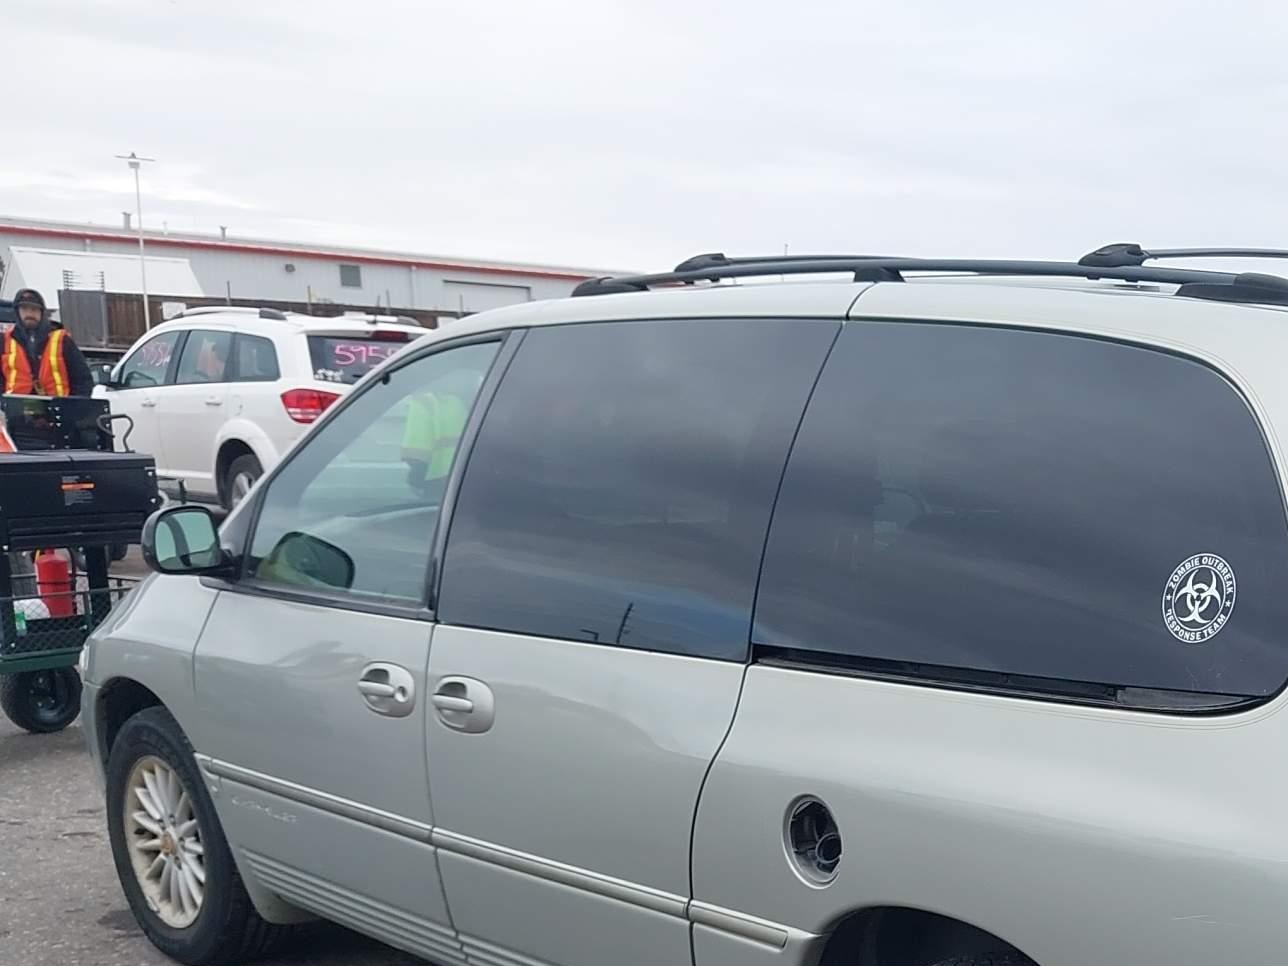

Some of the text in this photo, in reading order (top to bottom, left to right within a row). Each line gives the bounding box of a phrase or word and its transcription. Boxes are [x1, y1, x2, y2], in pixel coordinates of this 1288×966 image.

[1168, 556, 1234, 594] ZOMBIE OUTBREAK
[1166, 608, 1226, 641] RESPONSE TEAM
